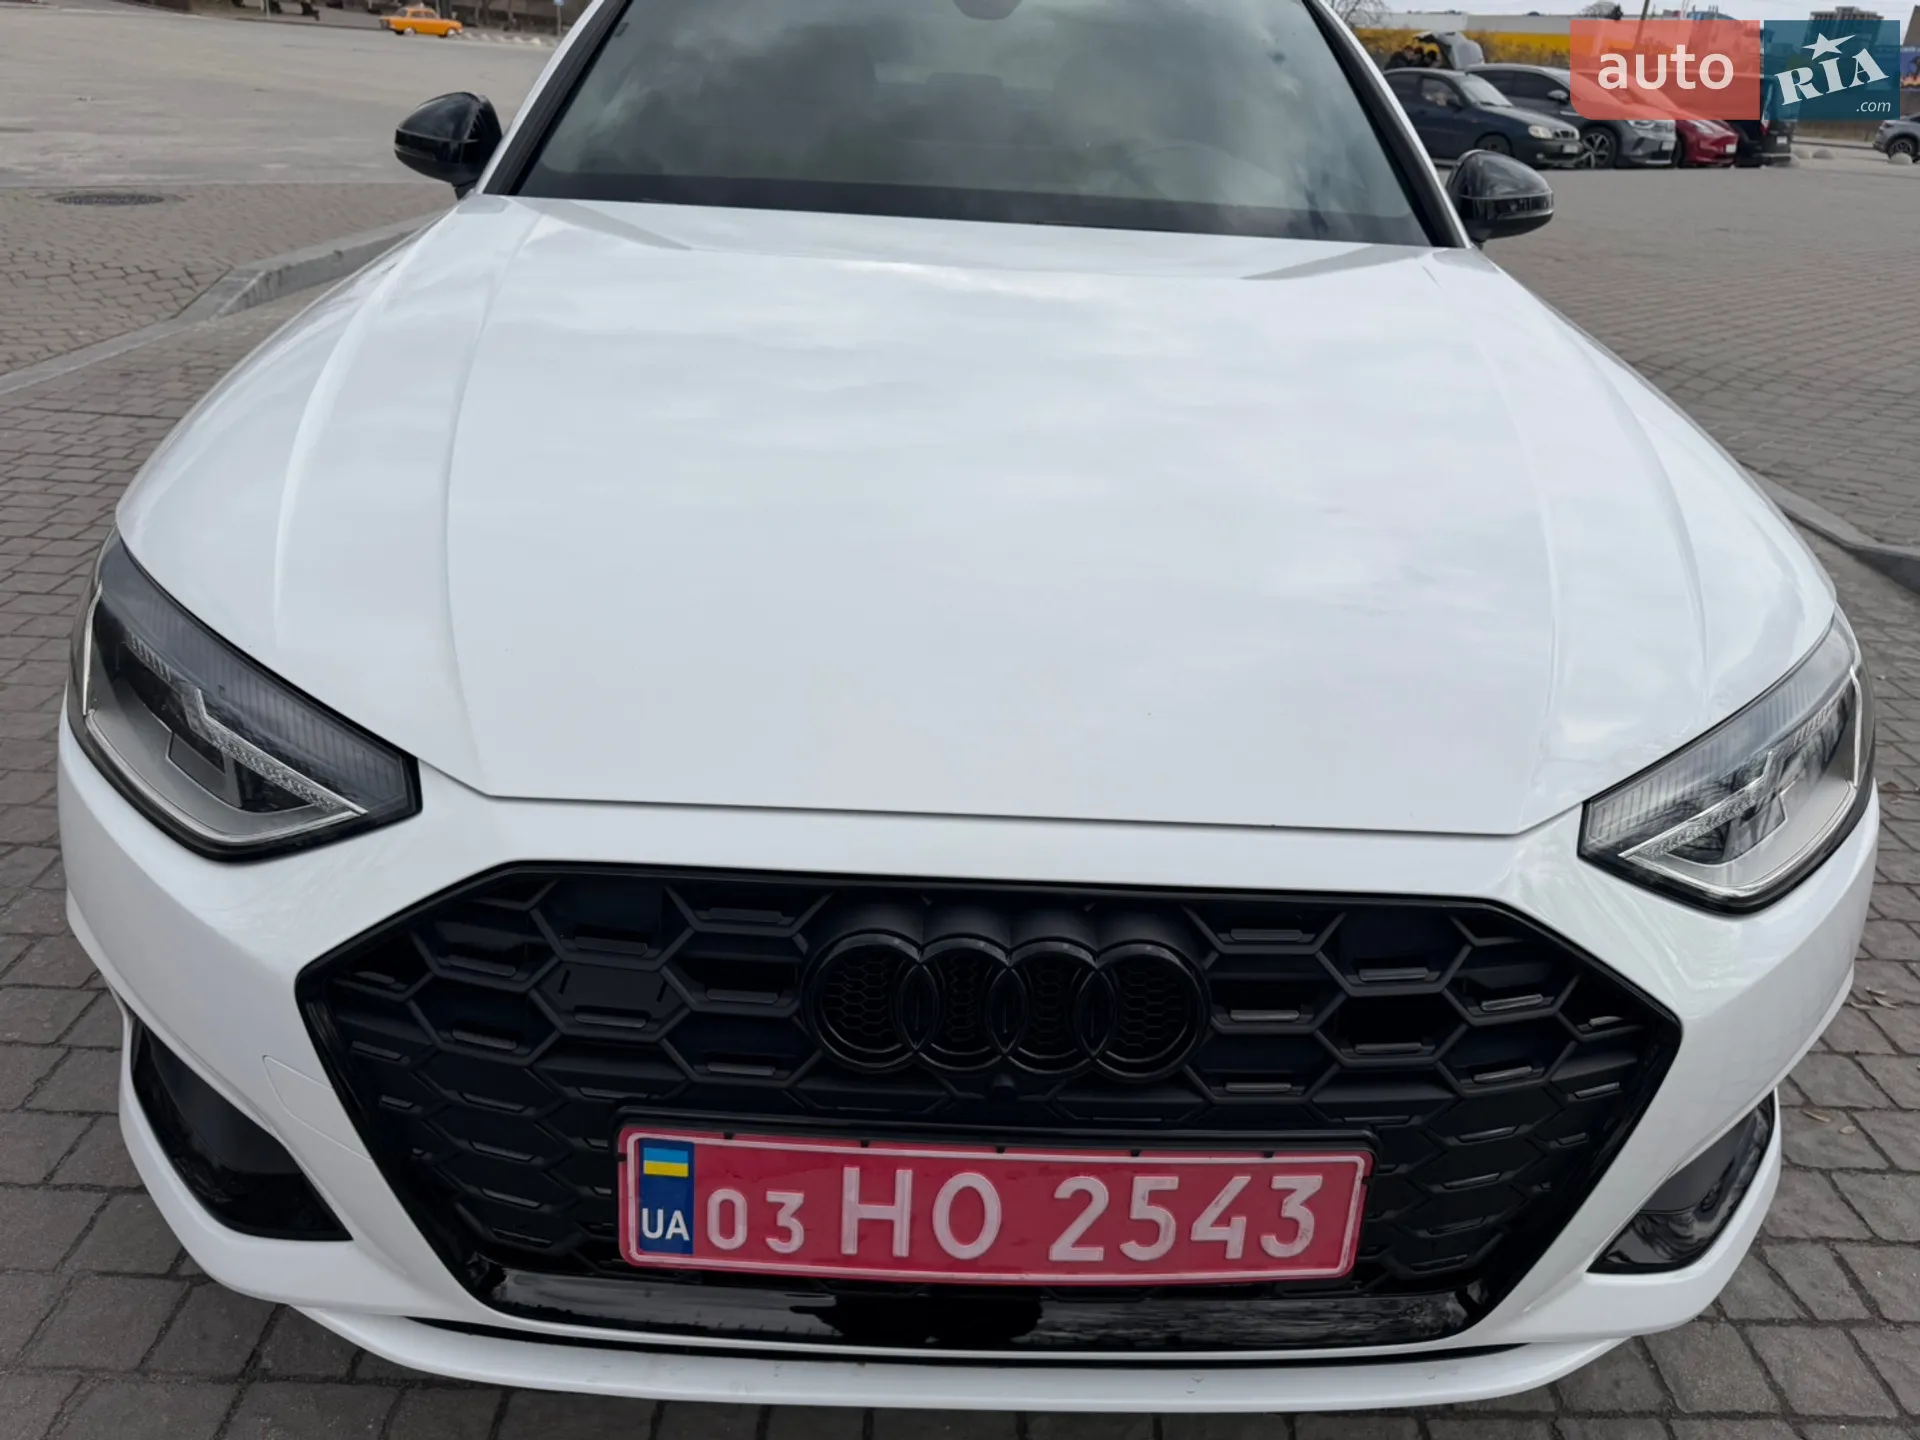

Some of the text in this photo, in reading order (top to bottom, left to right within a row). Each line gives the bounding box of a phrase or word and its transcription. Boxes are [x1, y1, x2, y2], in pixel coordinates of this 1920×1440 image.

[641, 1208, 690, 1242] UA
[706, 1166, 1323, 1262] 03 HO 2543
